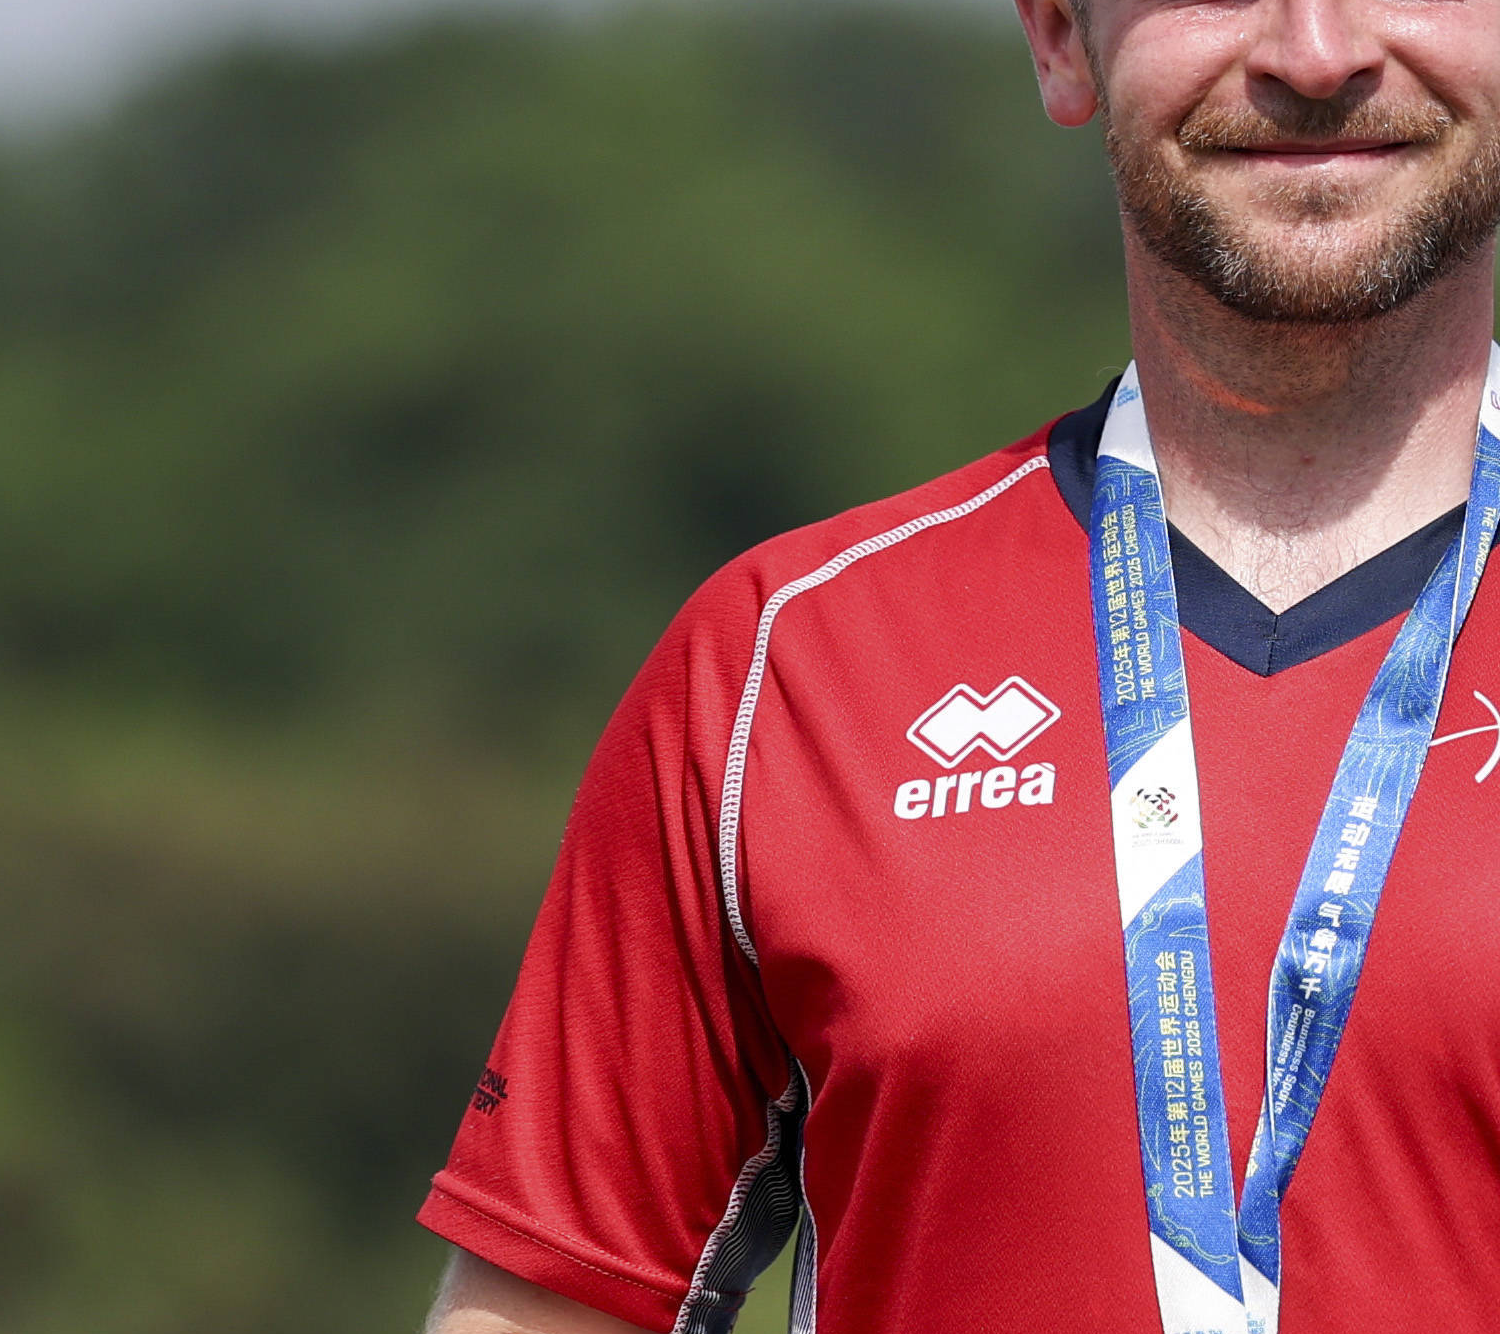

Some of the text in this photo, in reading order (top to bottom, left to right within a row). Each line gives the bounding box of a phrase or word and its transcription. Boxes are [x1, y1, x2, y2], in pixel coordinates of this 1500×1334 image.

[1474, 506, 1497, 577] THE WORLD
[1122, 503, 1157, 701] THE WORLD GAMES 2025 CHENGDU
[1277, 1003, 1303, 1066] Countless
[1289, 1007, 1316, 1074] Boundless
[1155, 950, 1197, 1199] 2025年第12届世界运动会
[1179, 950, 1215, 1198] THE WORLD GAMES 2025 CHENGDU
[1274, 1074, 1298, 1116] Sports
